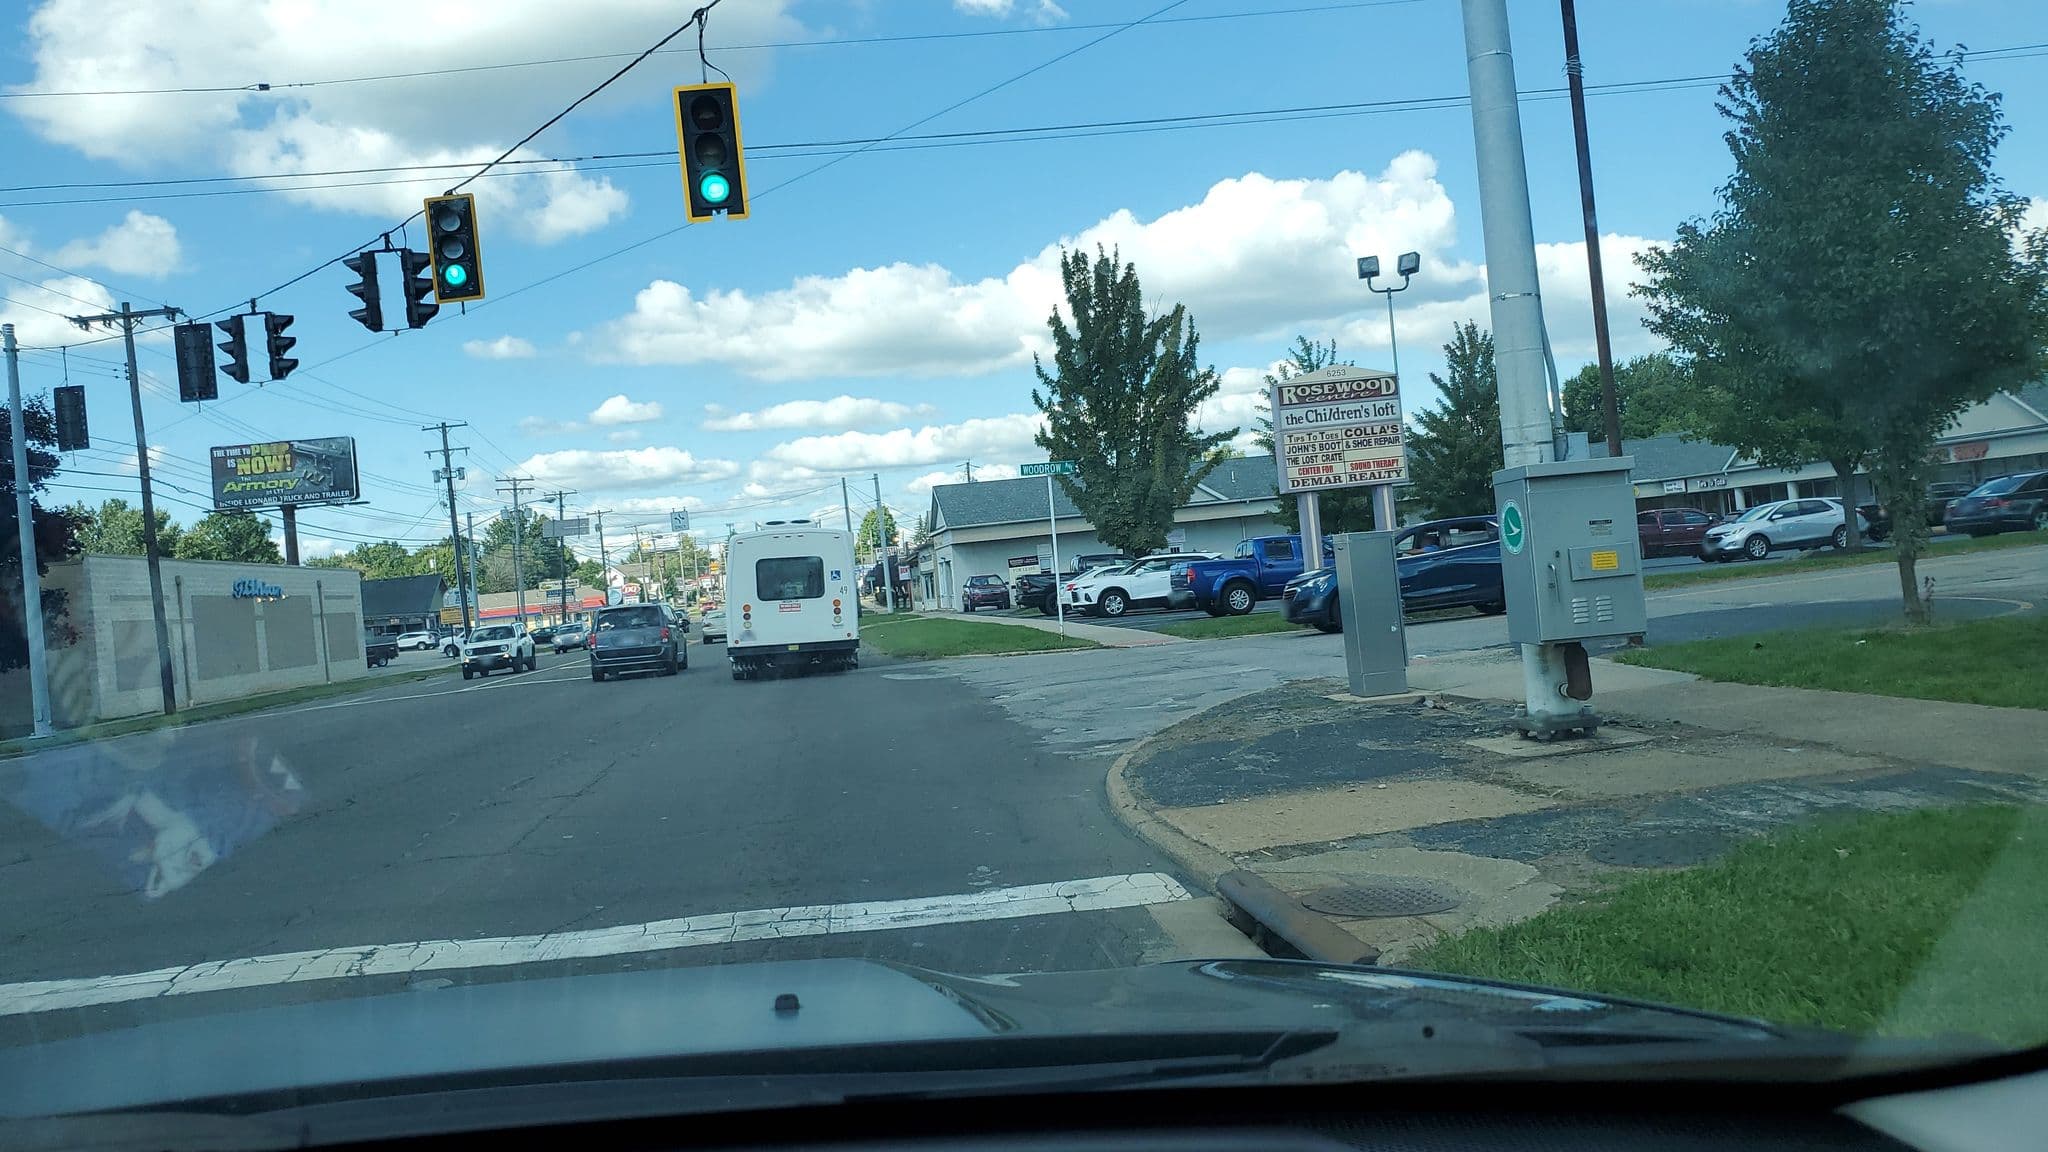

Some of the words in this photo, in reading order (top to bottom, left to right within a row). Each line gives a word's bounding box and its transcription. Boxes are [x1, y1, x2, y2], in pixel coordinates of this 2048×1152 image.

[1282, 378, 1396, 405] ROSEWOOD
[1306, 390, 1374, 402] centre
[1286, 414, 1304, 426] the
[1305, 404, 1370, 423] Children's
[1374, 402, 1396, 417] loft
[1344, 424, 1399, 438] COLLA'S
[213, 450, 225, 458] THE
[226, 448, 242, 456] TIME
[1286, 444, 1316, 454] JOHN'S
[1319, 442, 1340, 452] BOOT
[1345, 441, 1350, 449] &
[1352, 439, 1373, 448] SHOE
[1374, 436, 1400, 446] REPAIR
[228, 458, 236, 468] IS
[236, 454, 292, 476] NOW!
[1286, 457, 1300, 466] THE
[1302, 455, 1318, 464] LOST
[1322, 452, 1342, 462] CRATE
[1022, 464, 1061, 475] WOODROW
[1298, 466, 1320, 476] CENTER
[1322, 465, 1334, 474] FOR
[1350, 461, 1371, 471] SOUND
[1372, 459, 1399, 469] THERAPY
[223, 478, 300, 494] Armory
[1290, 475, 1343, 488] DEMAR
[1349, 470, 1402, 482] REALTY
[220, 500, 243, 508] INSIDE
[244, 496, 278, 505] LEONARD
[279, 494, 301, 503] TRUCK
[304, 492, 320, 500] AND
[322, 490, 350, 498] TRAILER
[840, 586, 848, 594] 49
